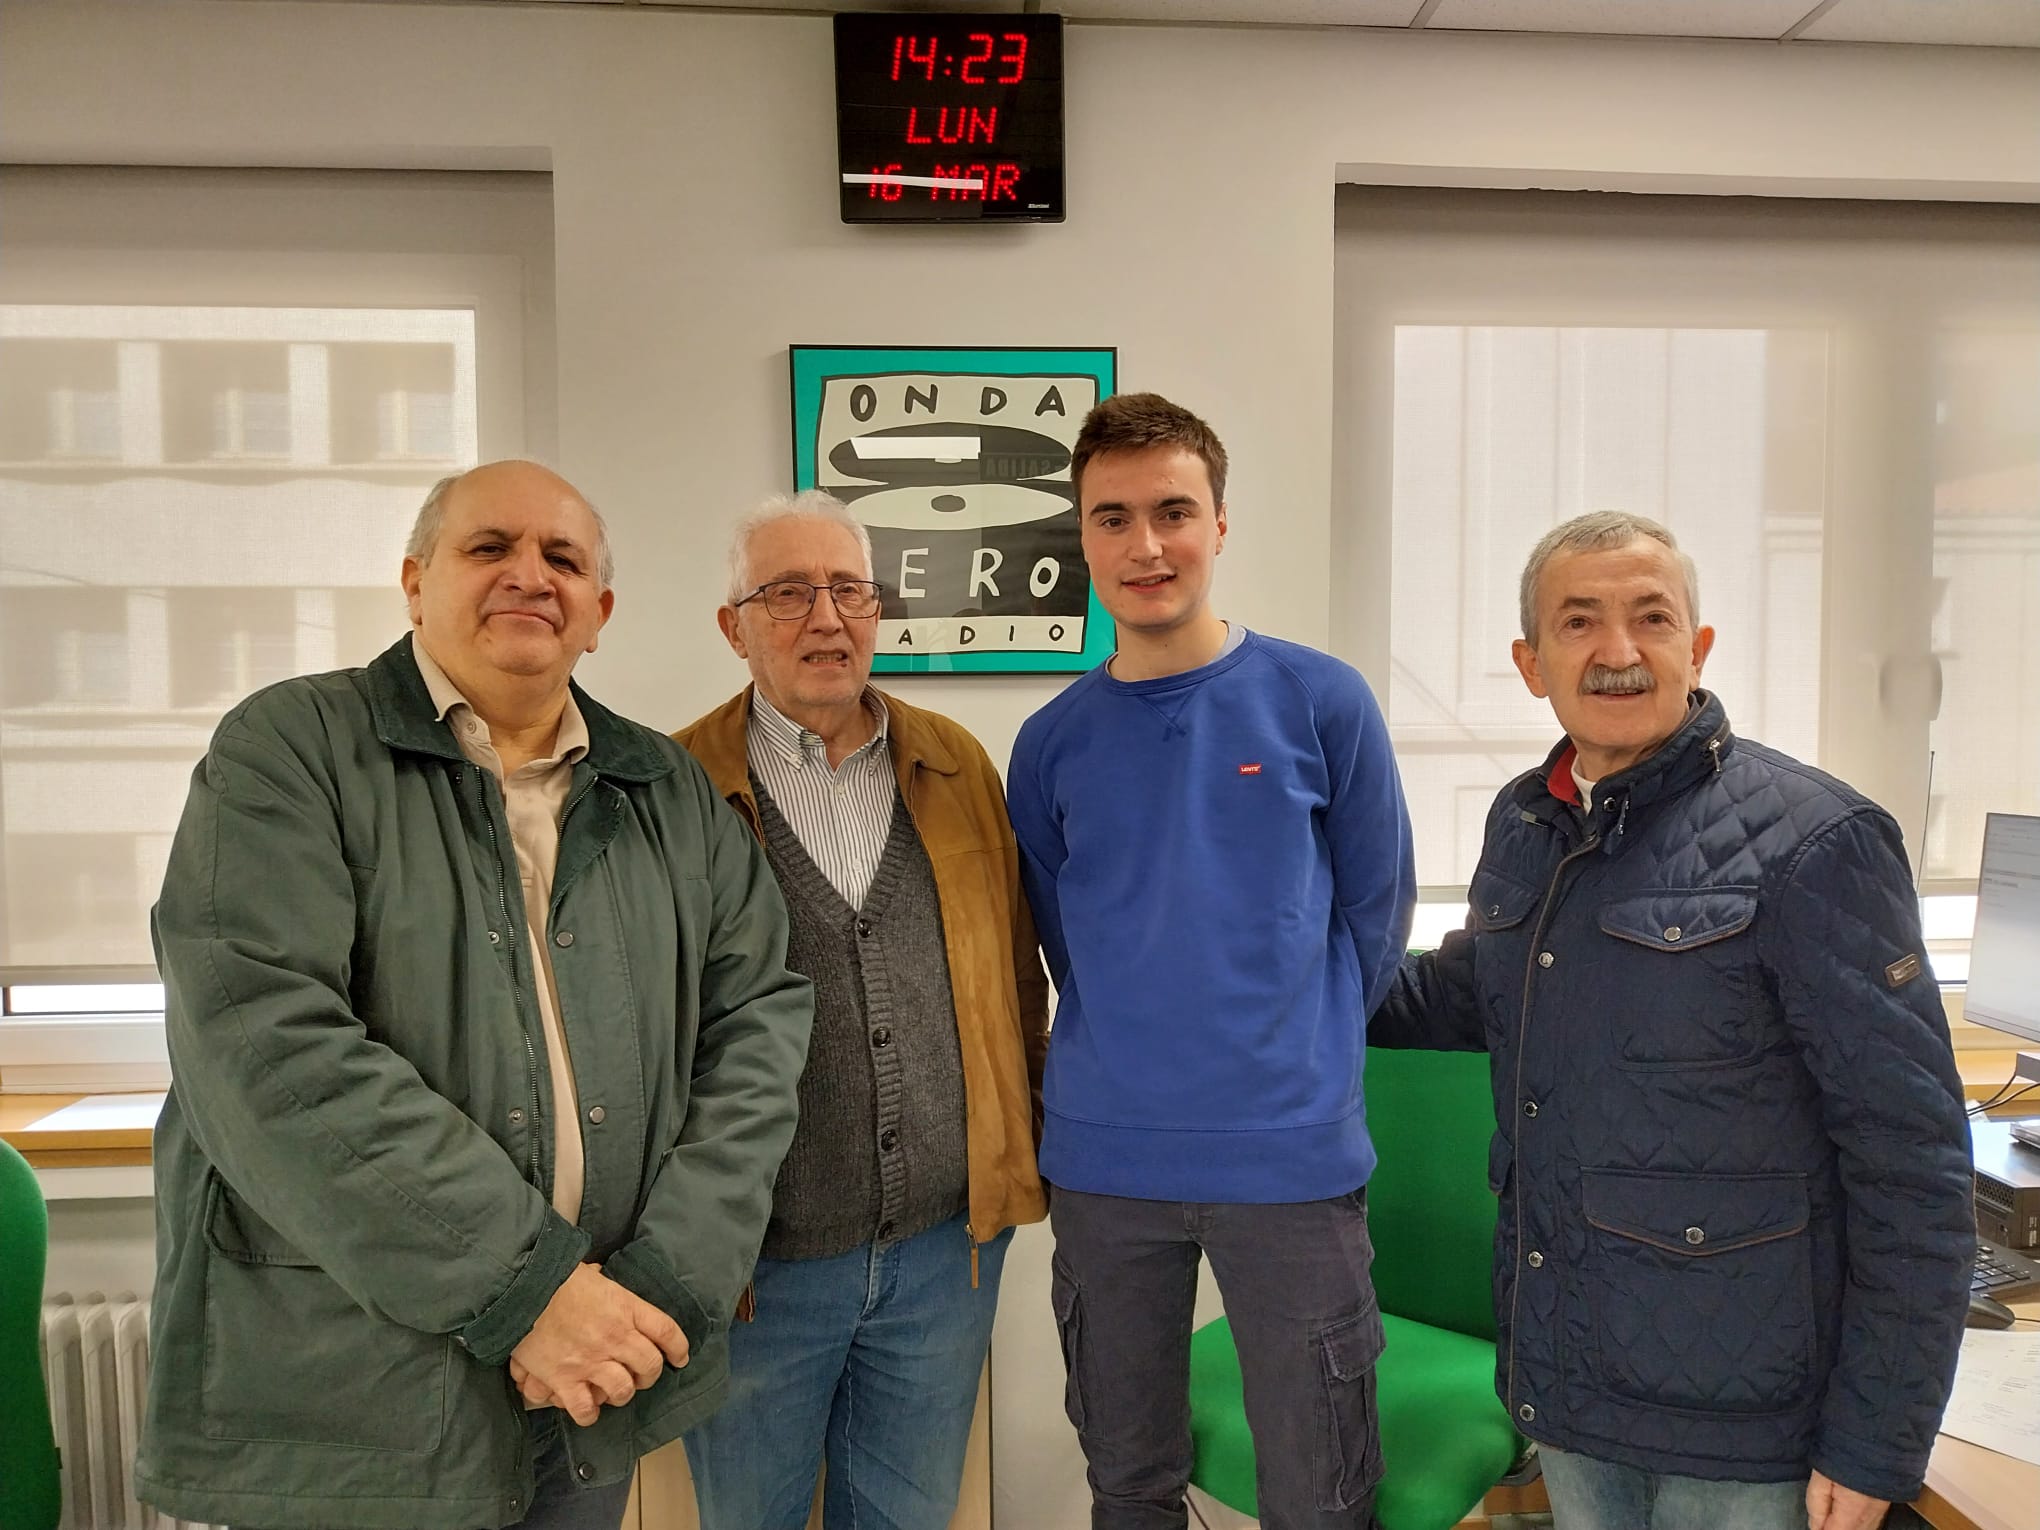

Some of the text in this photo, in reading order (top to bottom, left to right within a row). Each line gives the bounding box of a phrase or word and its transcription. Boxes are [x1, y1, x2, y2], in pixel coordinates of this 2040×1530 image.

[892, 33, 1027, 84] 14:23
[907, 107, 997, 143] LUN
[869, 164, 1020, 201] 16 MAR
[850, 384, 1066, 422] ONDA
[899, 548, 1060, 598] ERO
[898, 624, 1065, 645] ADIO
